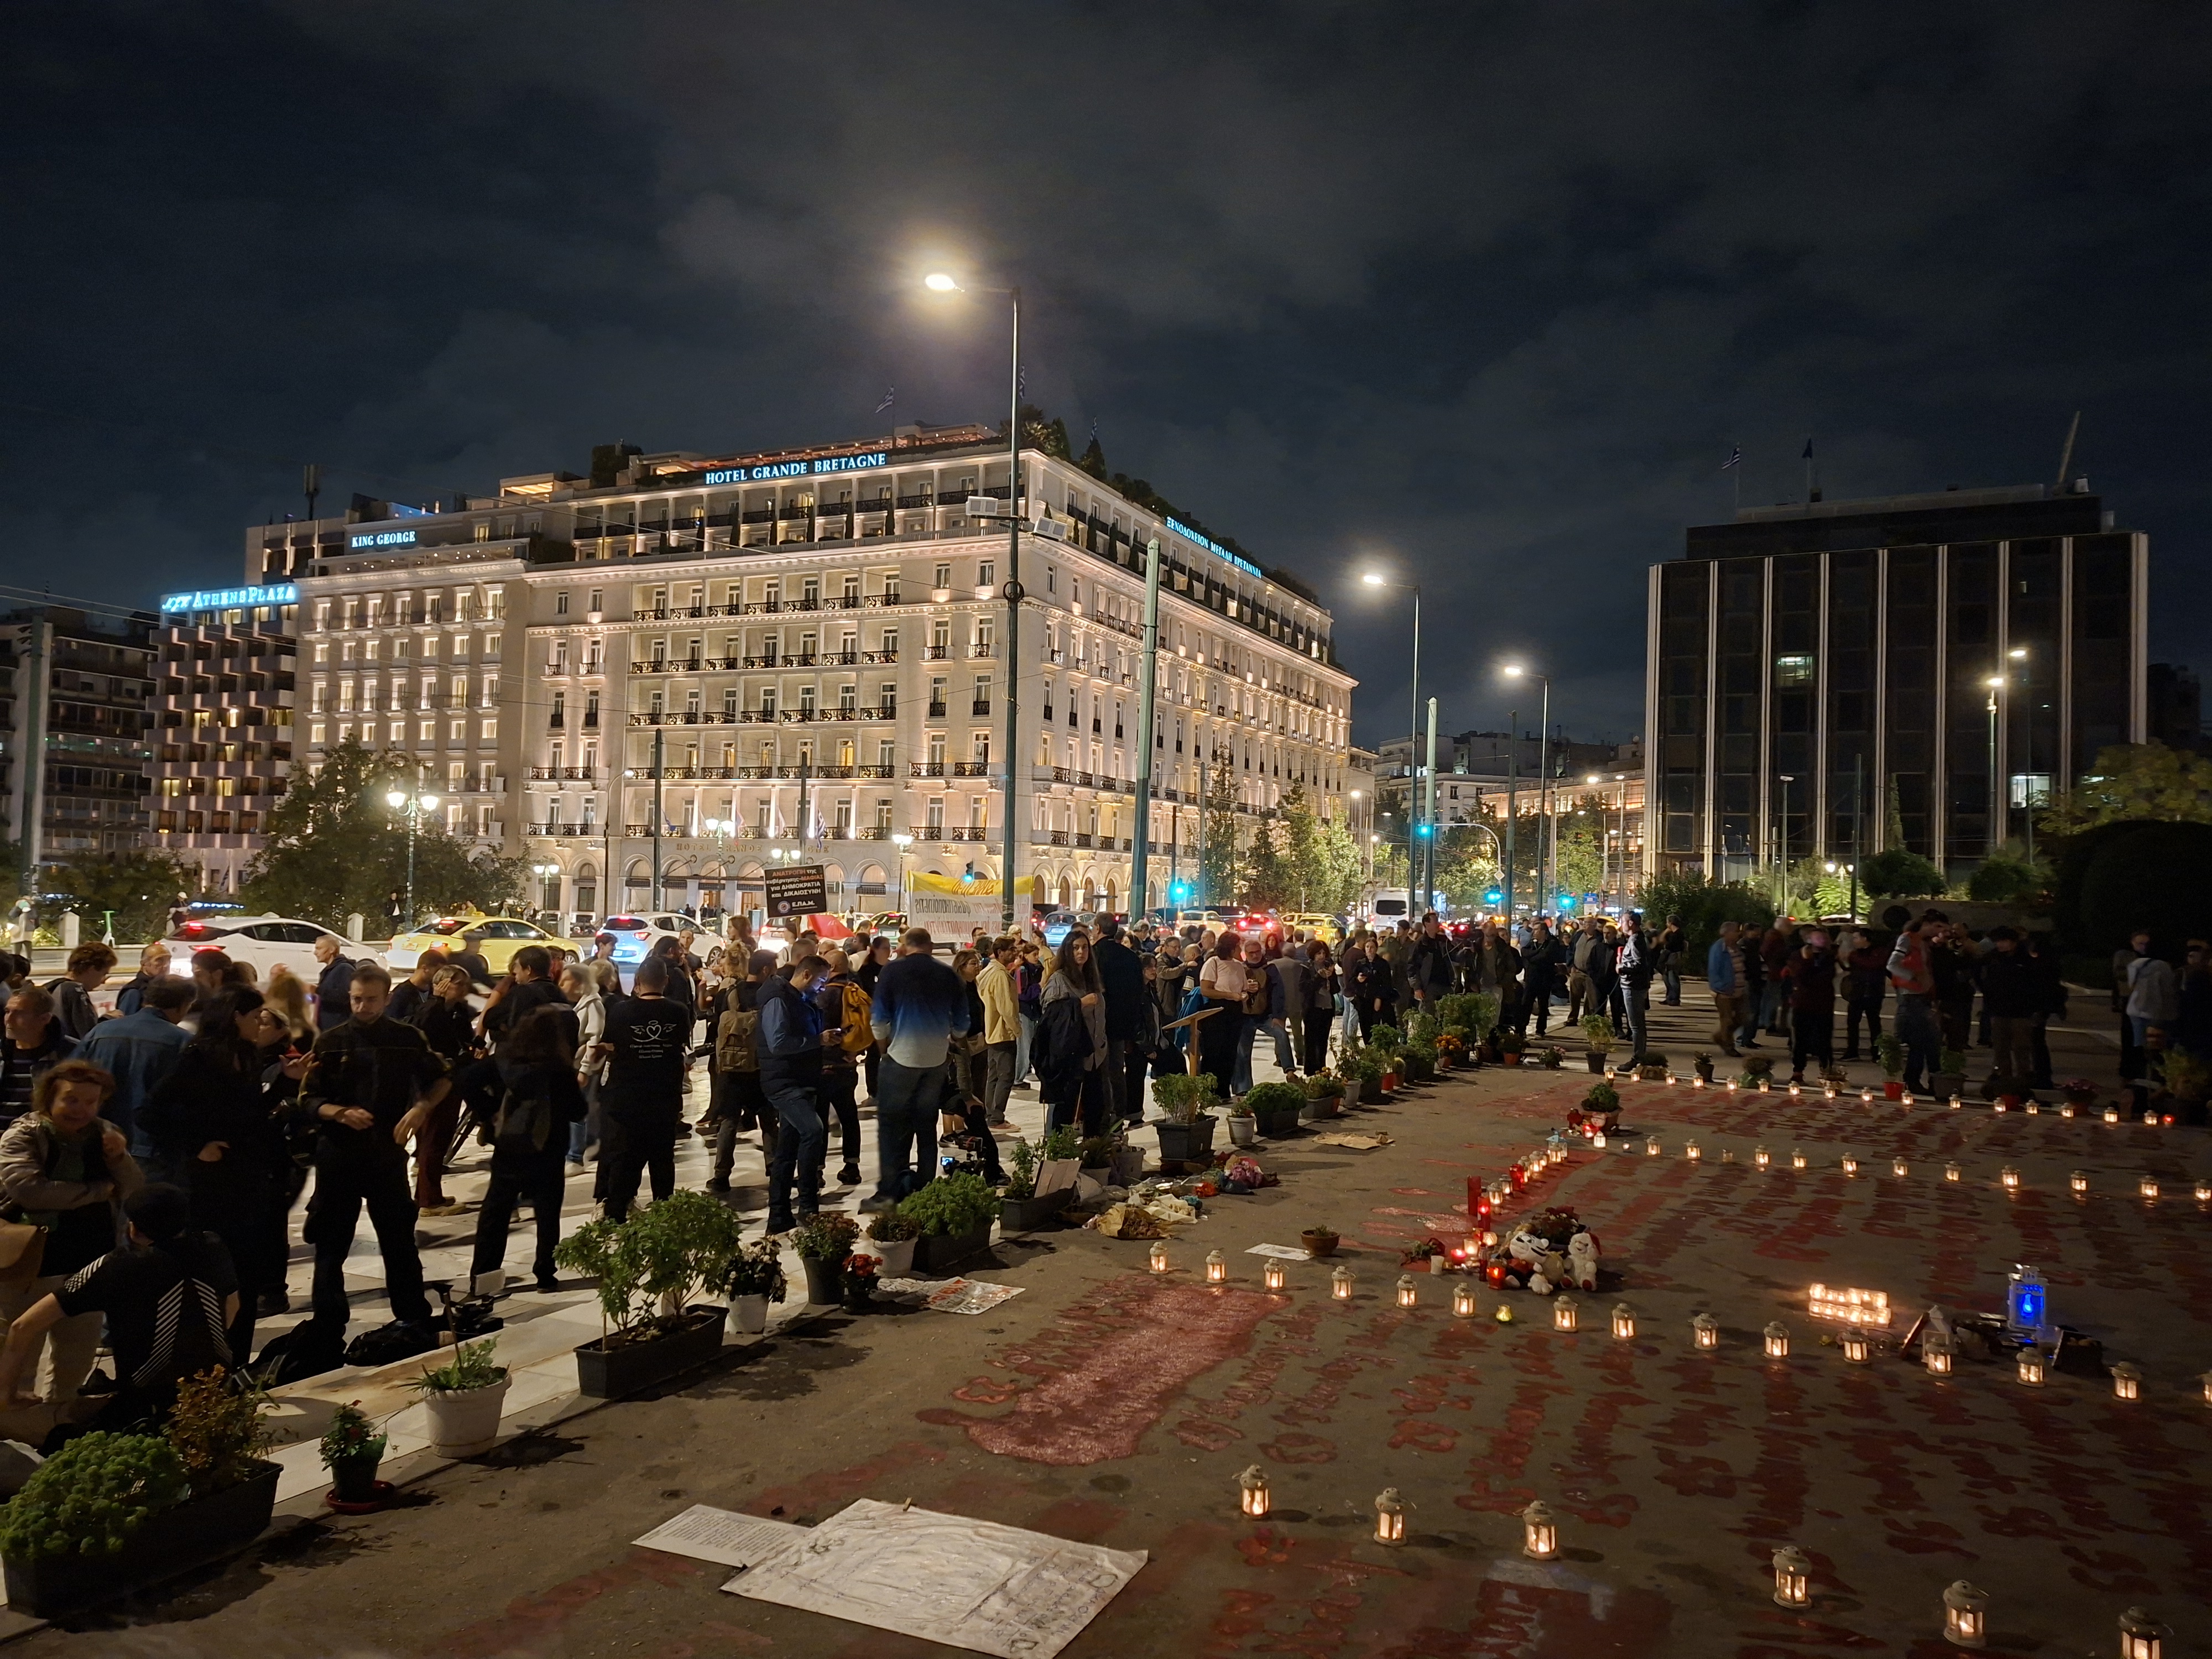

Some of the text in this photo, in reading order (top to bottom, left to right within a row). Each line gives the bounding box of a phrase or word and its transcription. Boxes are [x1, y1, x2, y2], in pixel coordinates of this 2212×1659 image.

[706, 453, 886, 484] HOTEL GRANDE BRETAGNE
[351, 531, 416, 548] KING GEORGE
[1166, 516, 1262, 579] ΞΕΝΟΔΟΧΕΙΟΝ ΜΕΓΑΛΗ ΒΡΕΤΑΝΝΙΑ
[676, 843, 711, 852] HOTEL
[719, 844, 762, 852] RANDE
[772, 869, 806, 877] ΑΝΑΤΡΟΠΗ
[781, 881, 821, 890] ΔΗΜΟΚΡΑΤΙΑ
[784, 888, 821, 897] ΔΙΚΑΙΟΣΥΝΗ
